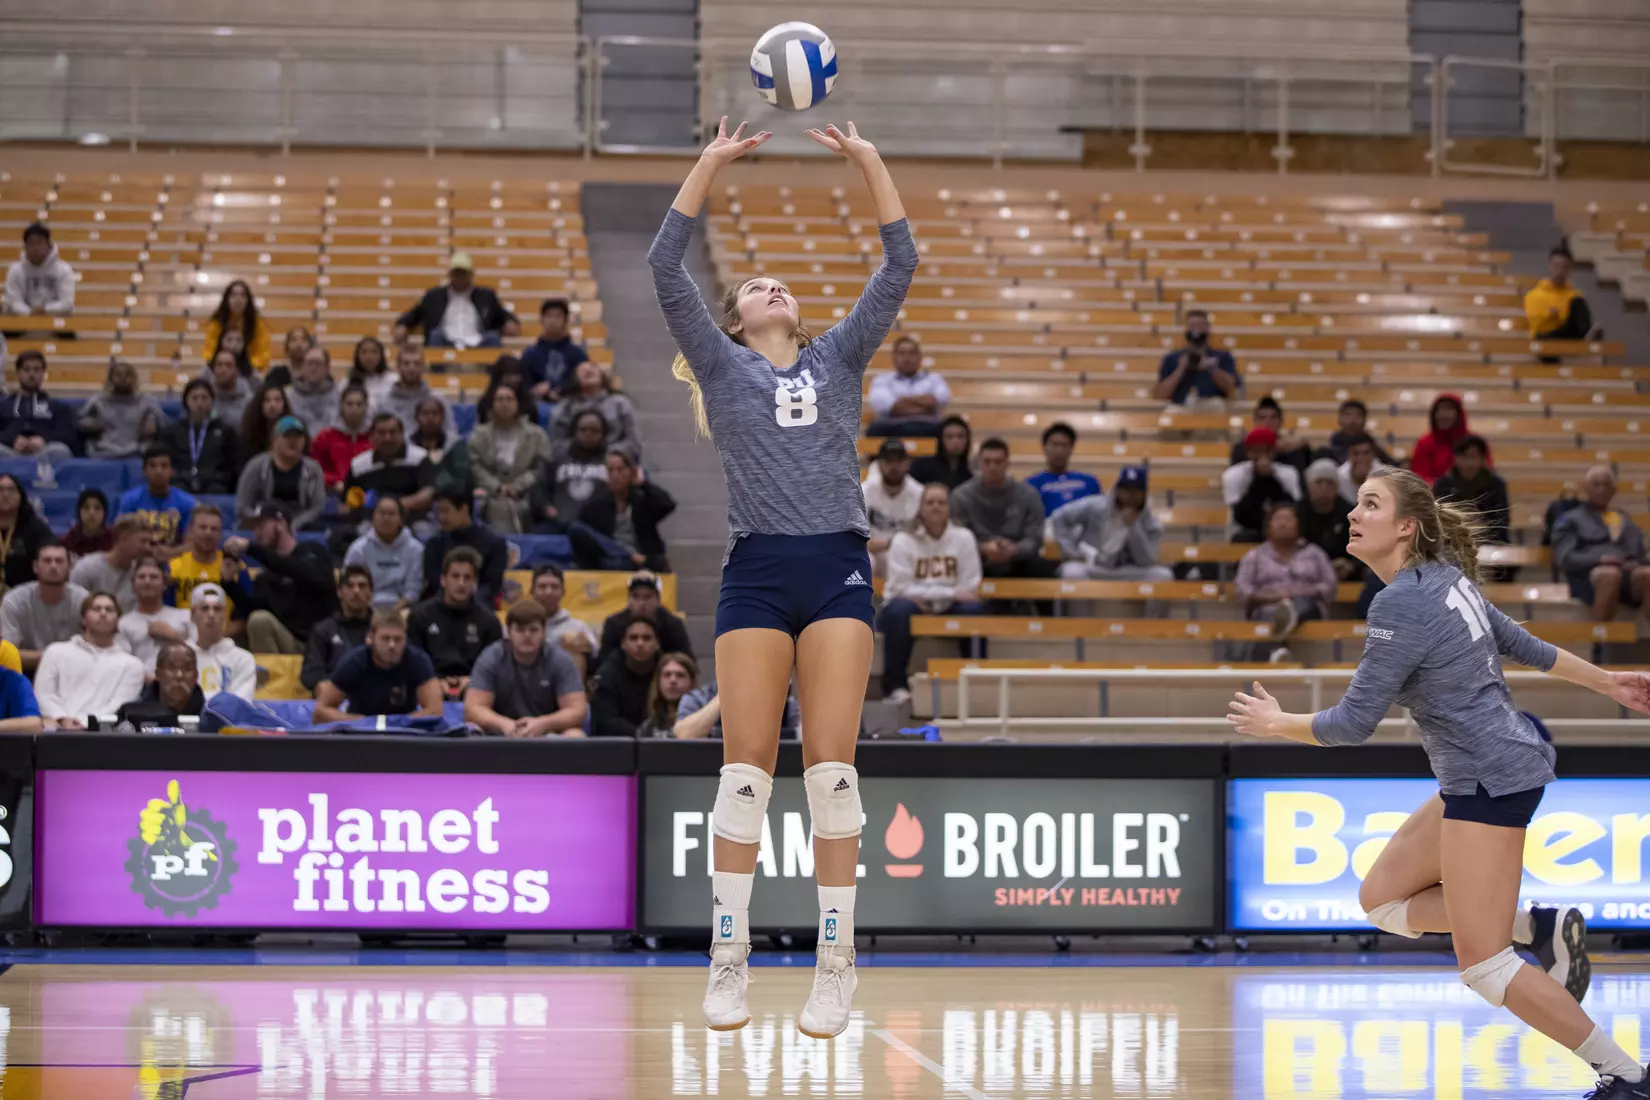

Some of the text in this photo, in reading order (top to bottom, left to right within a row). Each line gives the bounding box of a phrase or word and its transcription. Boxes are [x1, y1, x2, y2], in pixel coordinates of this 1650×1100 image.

[775, 387, 818, 427] 8
[1368, 627, 1394, 640] WAC
[257, 793, 500, 864] planet
[673, 811, 1181, 878] FAM BROILER
[1263, 791, 1650, 886] Baer
[151, 841, 215, 880] pf
[293, 851, 550, 914] fitness
[994, 888, 1182, 906] SIMPLY HEALTHY
[1262, 900, 1306, 921] On
